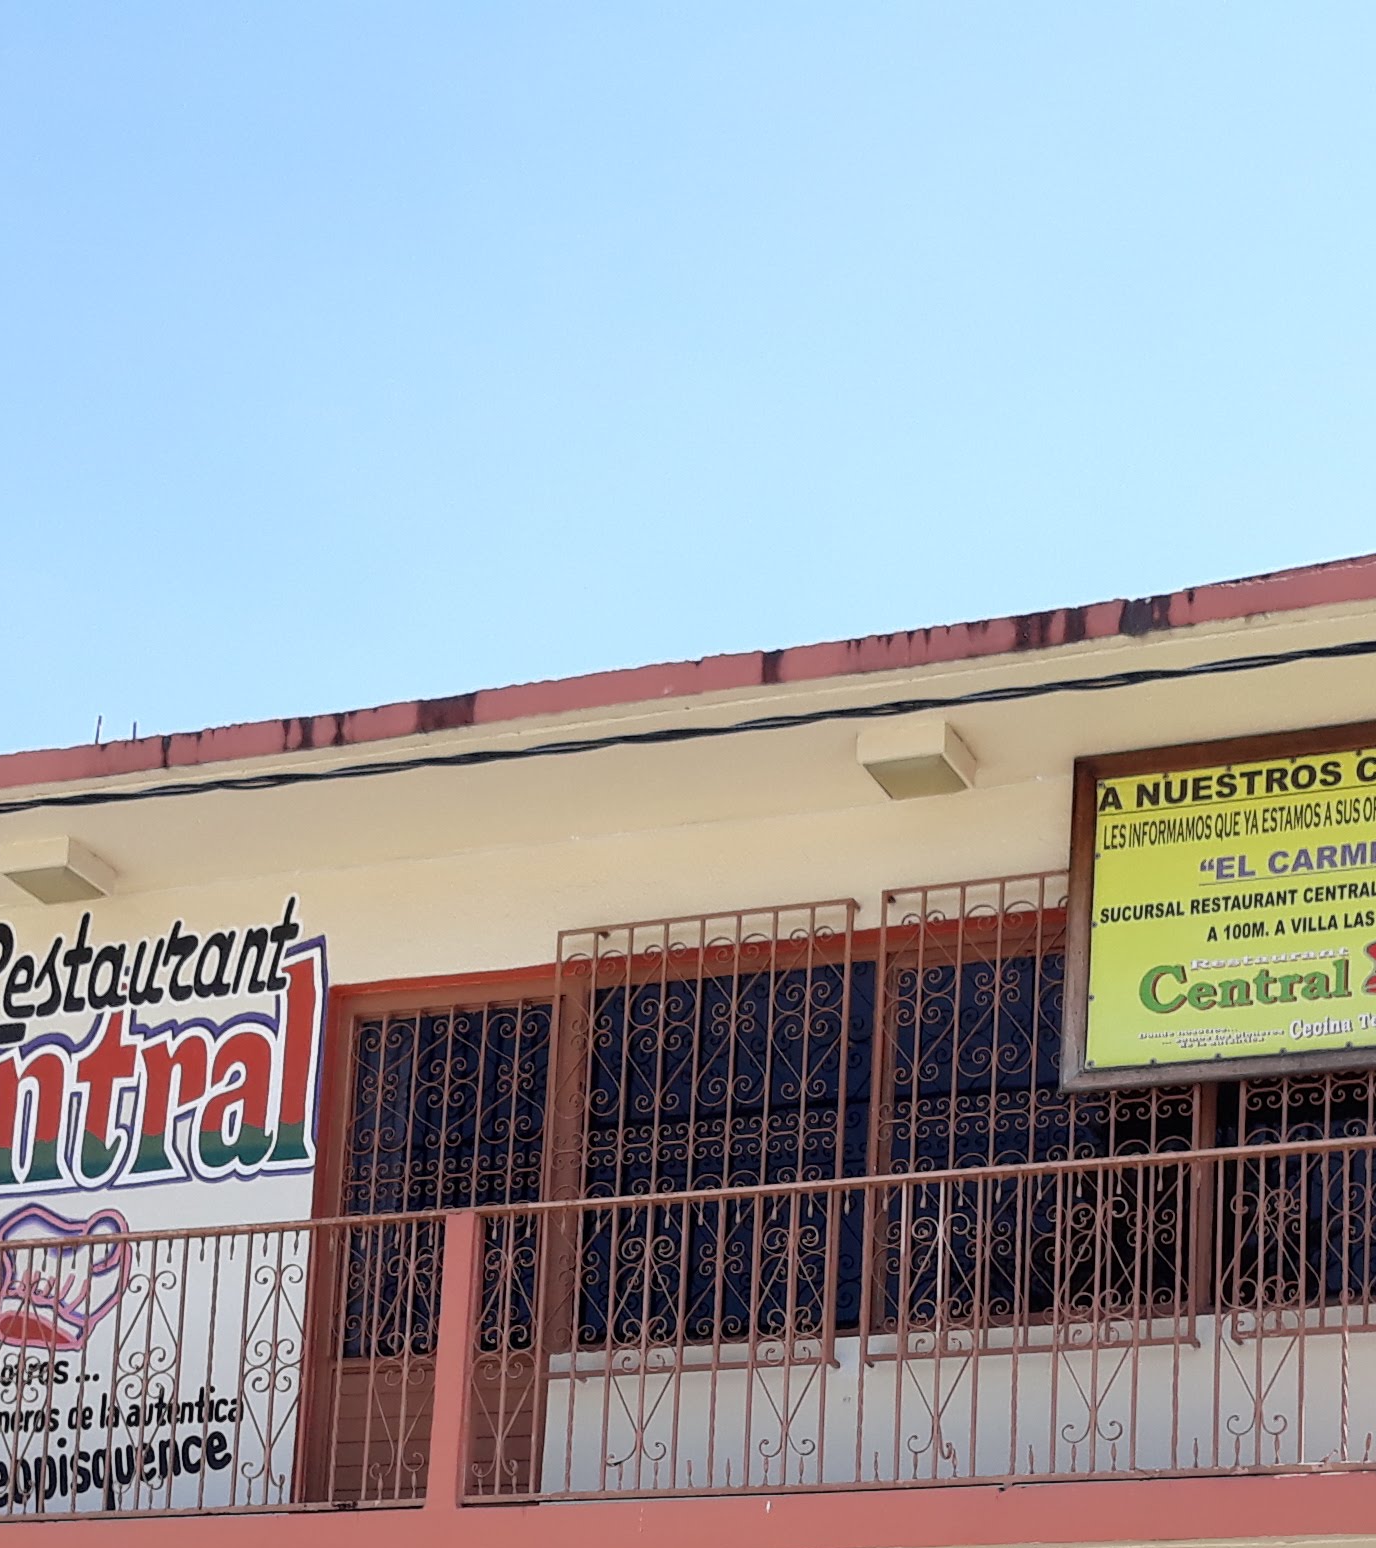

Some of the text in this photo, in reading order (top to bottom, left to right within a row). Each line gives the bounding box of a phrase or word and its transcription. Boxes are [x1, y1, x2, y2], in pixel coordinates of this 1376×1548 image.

[1099, 787, 1122, 811] A
[1136, 761, 1342, 808] NUESTROS
[1104, 824, 1126, 849] LES
[1129, 815, 1212, 847] INFORMAMOS
[1215, 812, 1240, 840] QUE
[1244, 809, 1258, 835] YA
[1262, 803, 1320, 833] ESTAMOS
[1323, 802, 1332, 826] A
[1336, 798, 1360, 825] SUS
[1100, 901, 1184, 924] SUCURSAL
[1190, 889, 1298, 915] RESTAURANT
[1207, 926, 1218, 942] A
[1224, 921, 1269, 940] 100M.
[1274, 919, 1285, 936] A
[1291, 914, 1338, 934] VILLA
[1344, 911, 1374, 929] LAS
[1190, 947, 1349, 971] Restaurant
[1139, 958, 1352, 1014] Central
[99, 1392, 120, 1428] la
